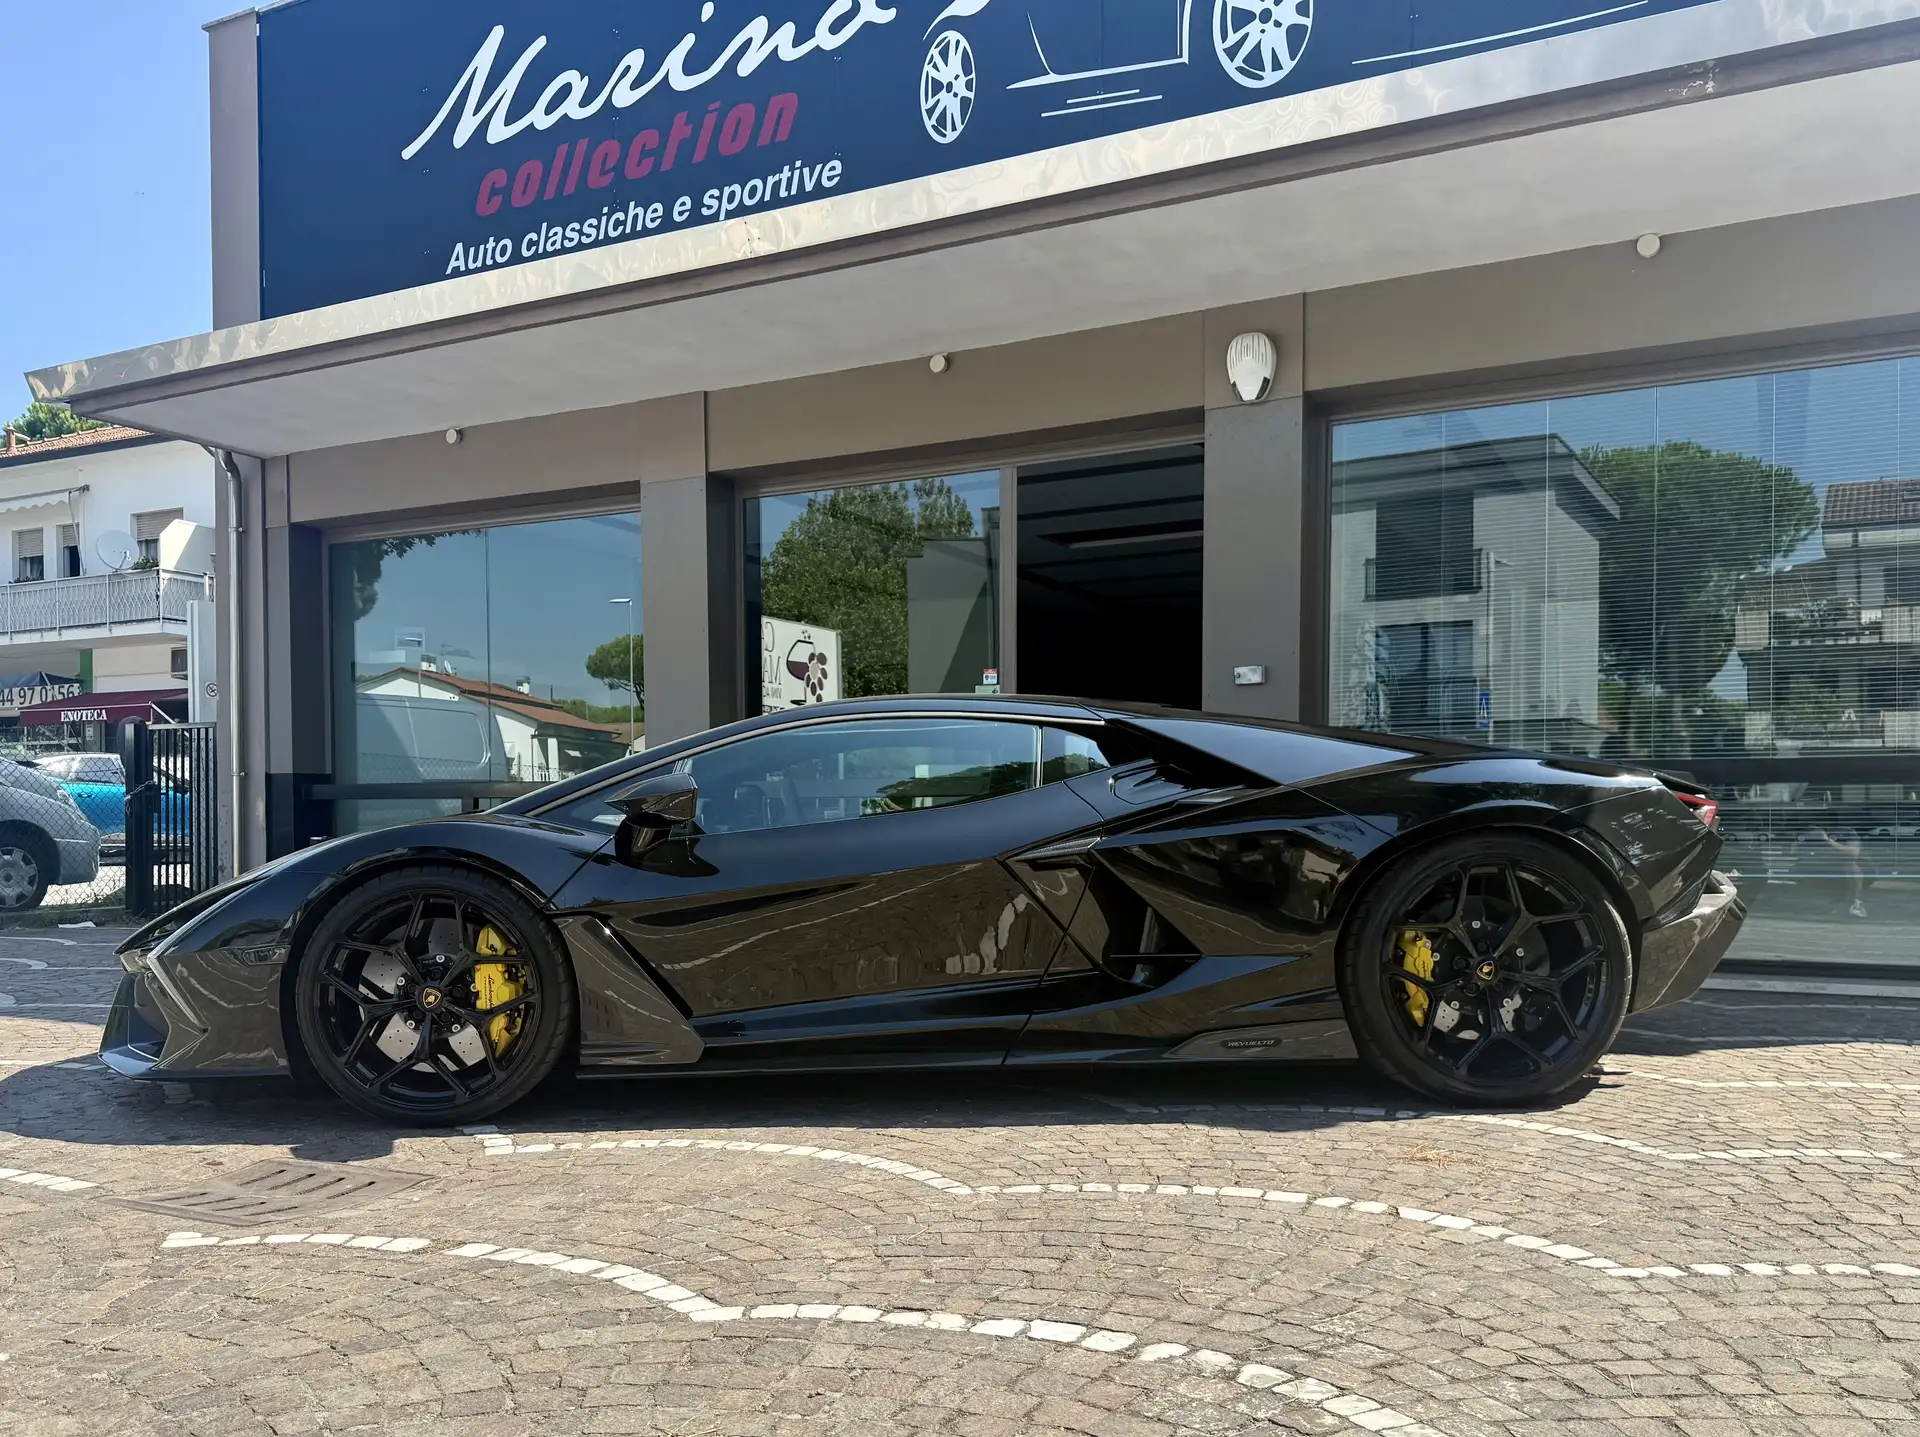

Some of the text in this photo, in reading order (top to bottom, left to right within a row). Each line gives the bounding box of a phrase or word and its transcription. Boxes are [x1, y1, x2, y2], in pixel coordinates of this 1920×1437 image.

[476, 93, 798, 216] collection
[447, 159, 842, 274] Auto classiche e sportive
[18, 687, 36, 705] 97
[61, 709, 107, 722] ENOTECA
